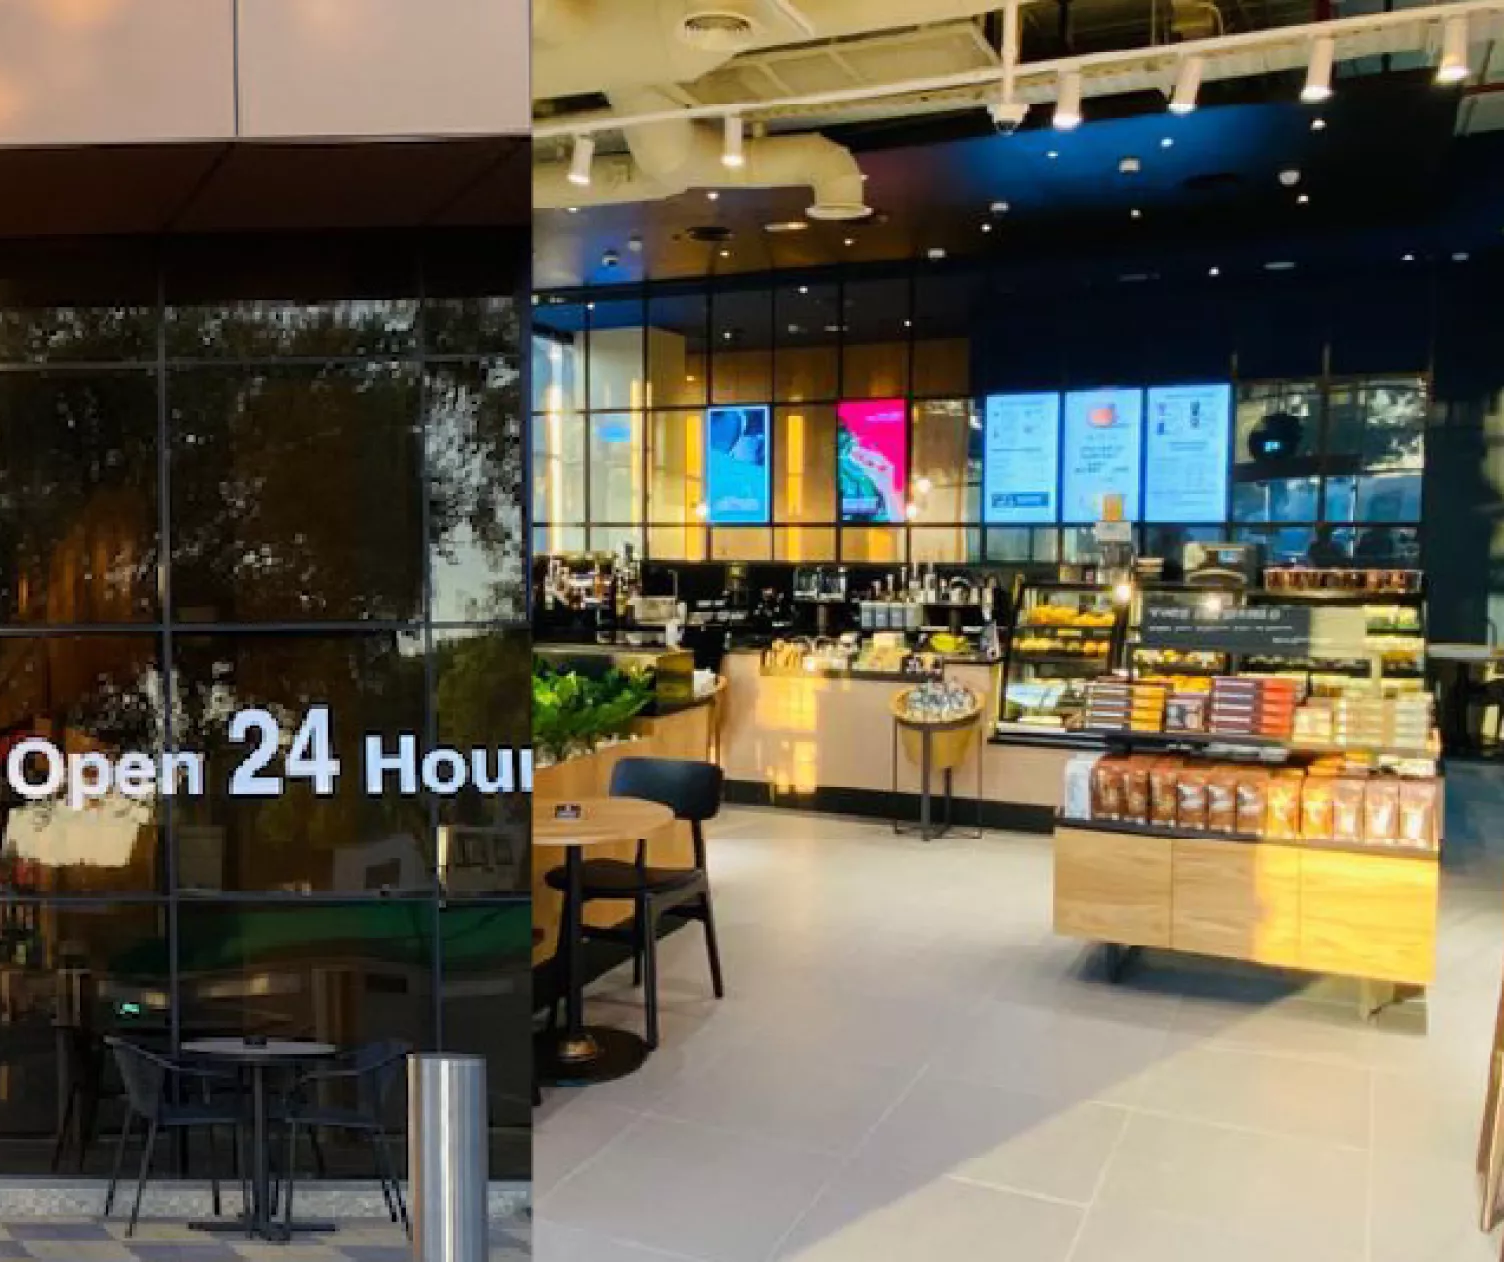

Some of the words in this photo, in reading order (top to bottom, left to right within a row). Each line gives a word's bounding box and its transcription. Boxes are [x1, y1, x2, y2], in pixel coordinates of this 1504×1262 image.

[7, 737, 205, 811] Open
[228, 704, 341, 795] 24
[365, 734, 533, 794] Hour
